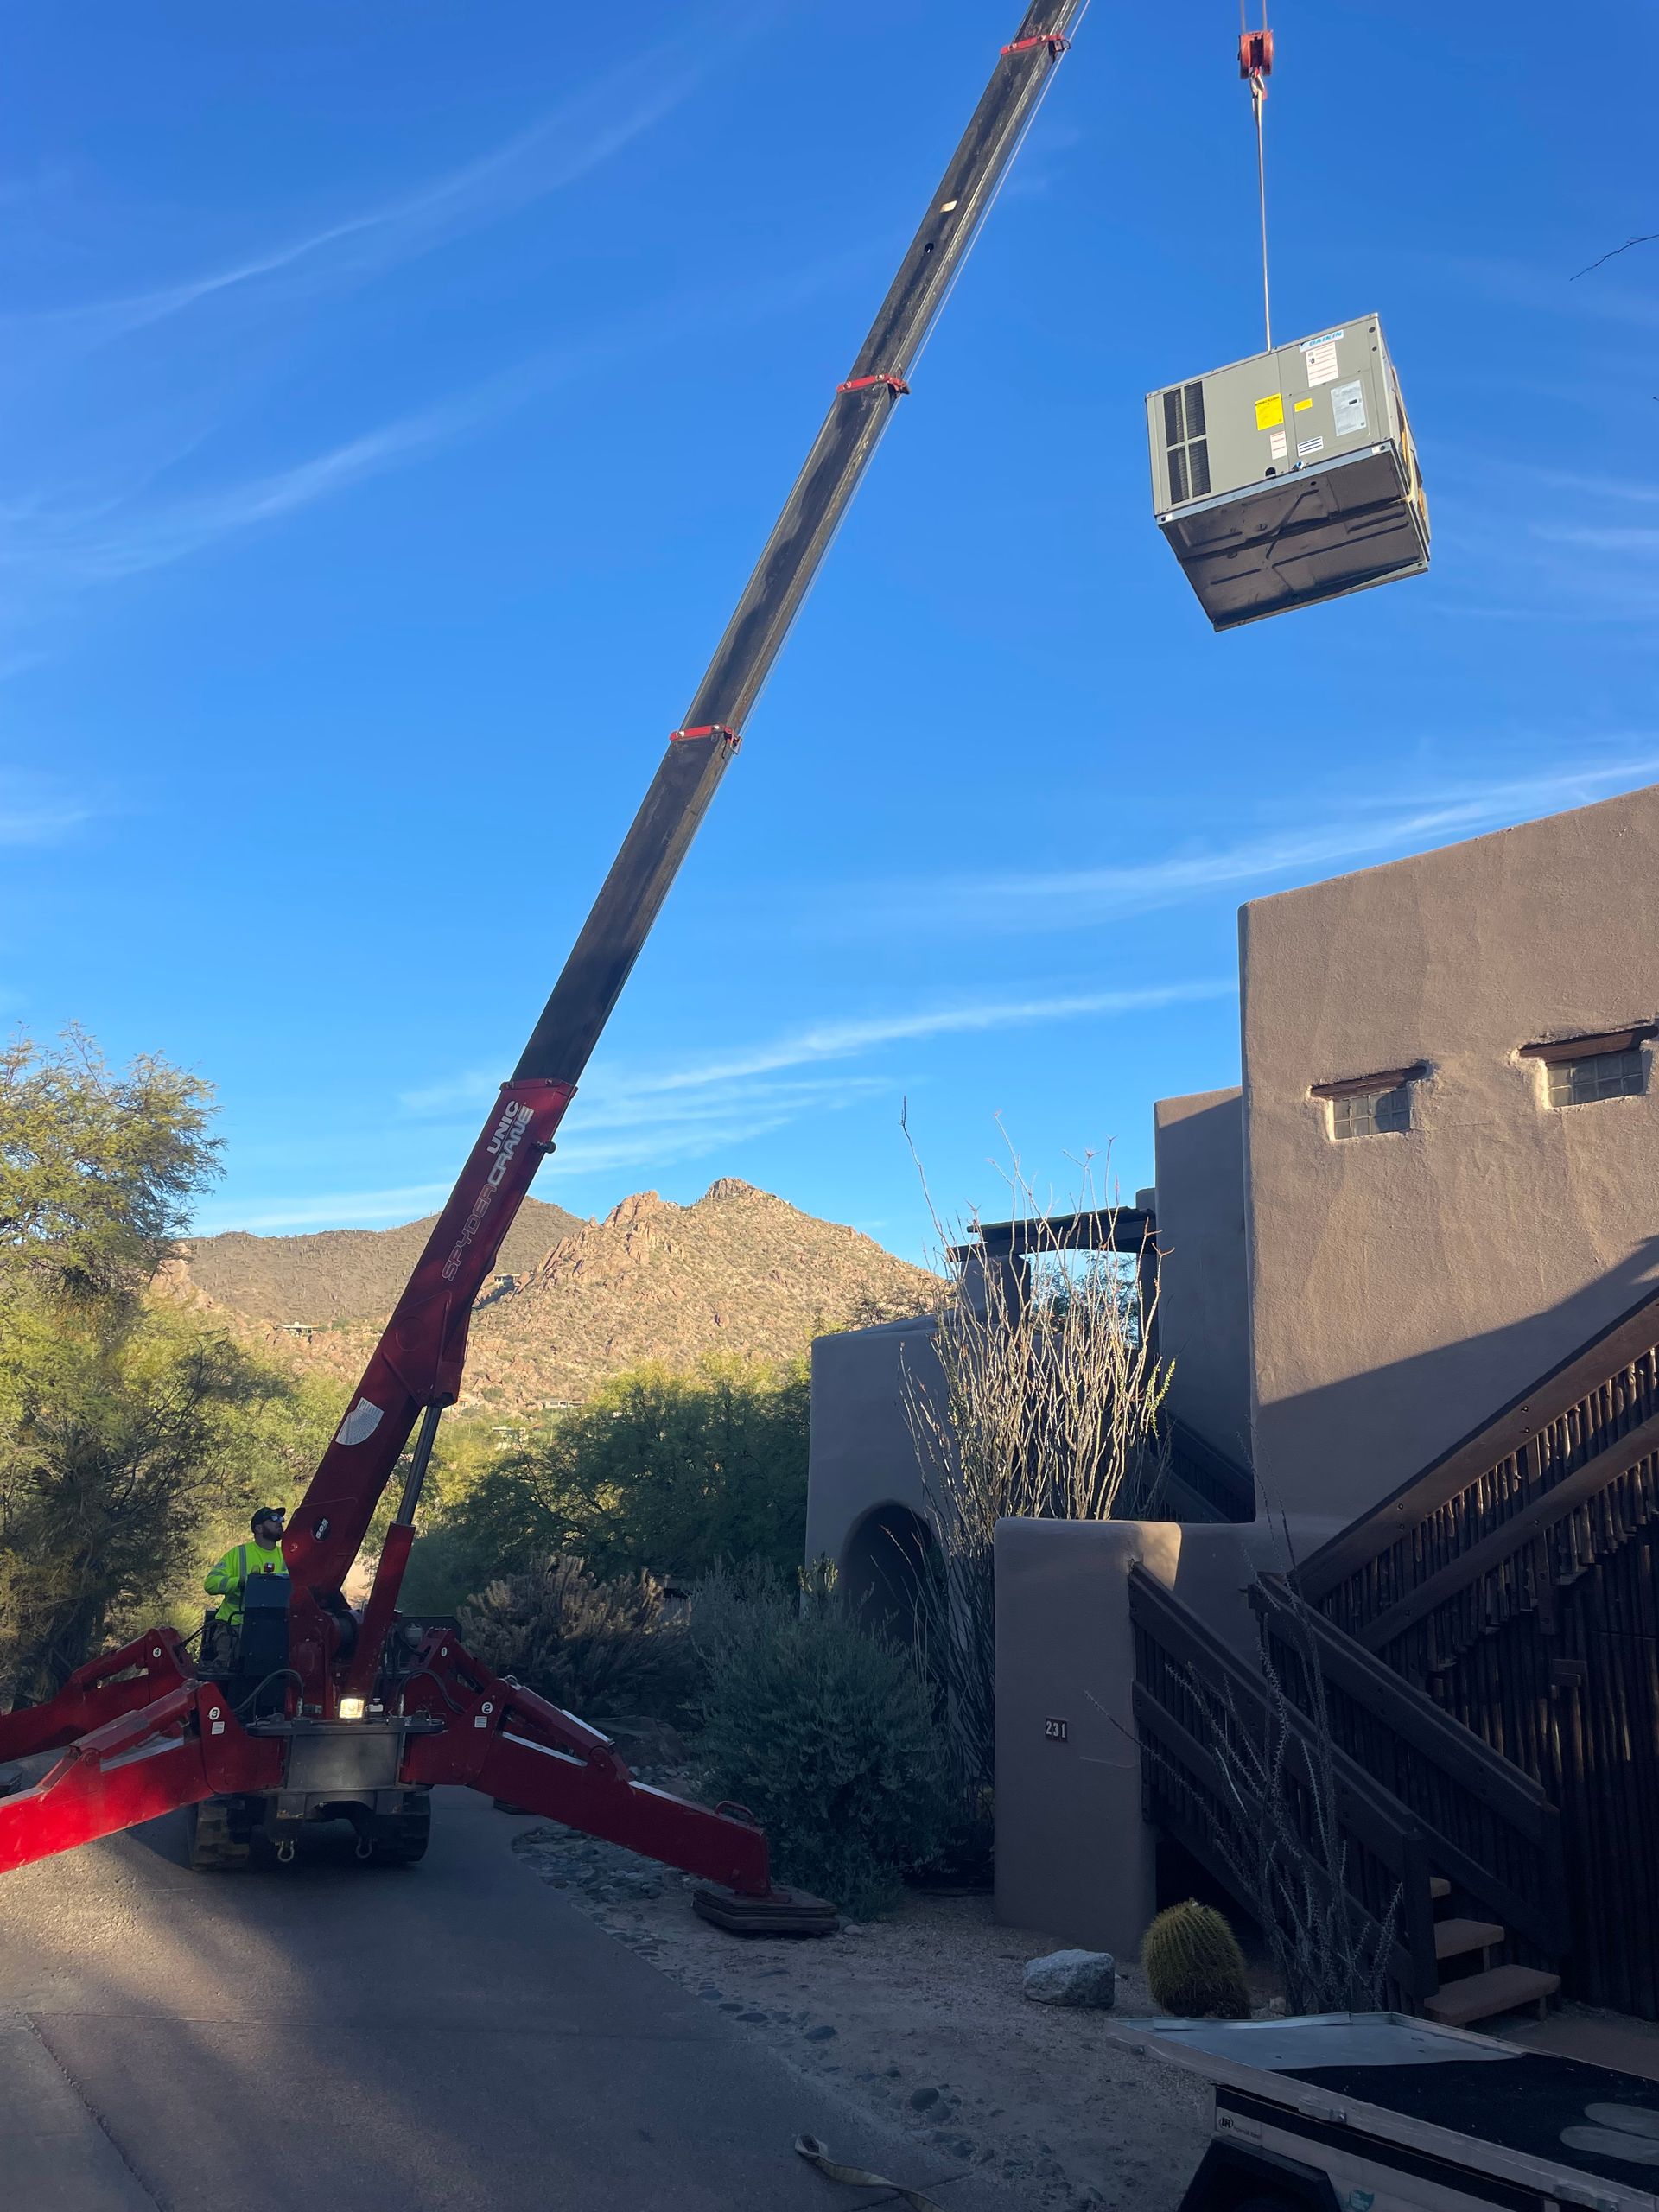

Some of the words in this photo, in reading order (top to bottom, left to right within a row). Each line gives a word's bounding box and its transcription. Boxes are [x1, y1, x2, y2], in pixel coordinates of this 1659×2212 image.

[1309, 332, 1342, 346] DAIKIN
[486, 1100, 519, 1154] UNIC
[442, 1105, 535, 1282] SPYDERCRANE
[1046, 1720, 1066, 1738] 231
